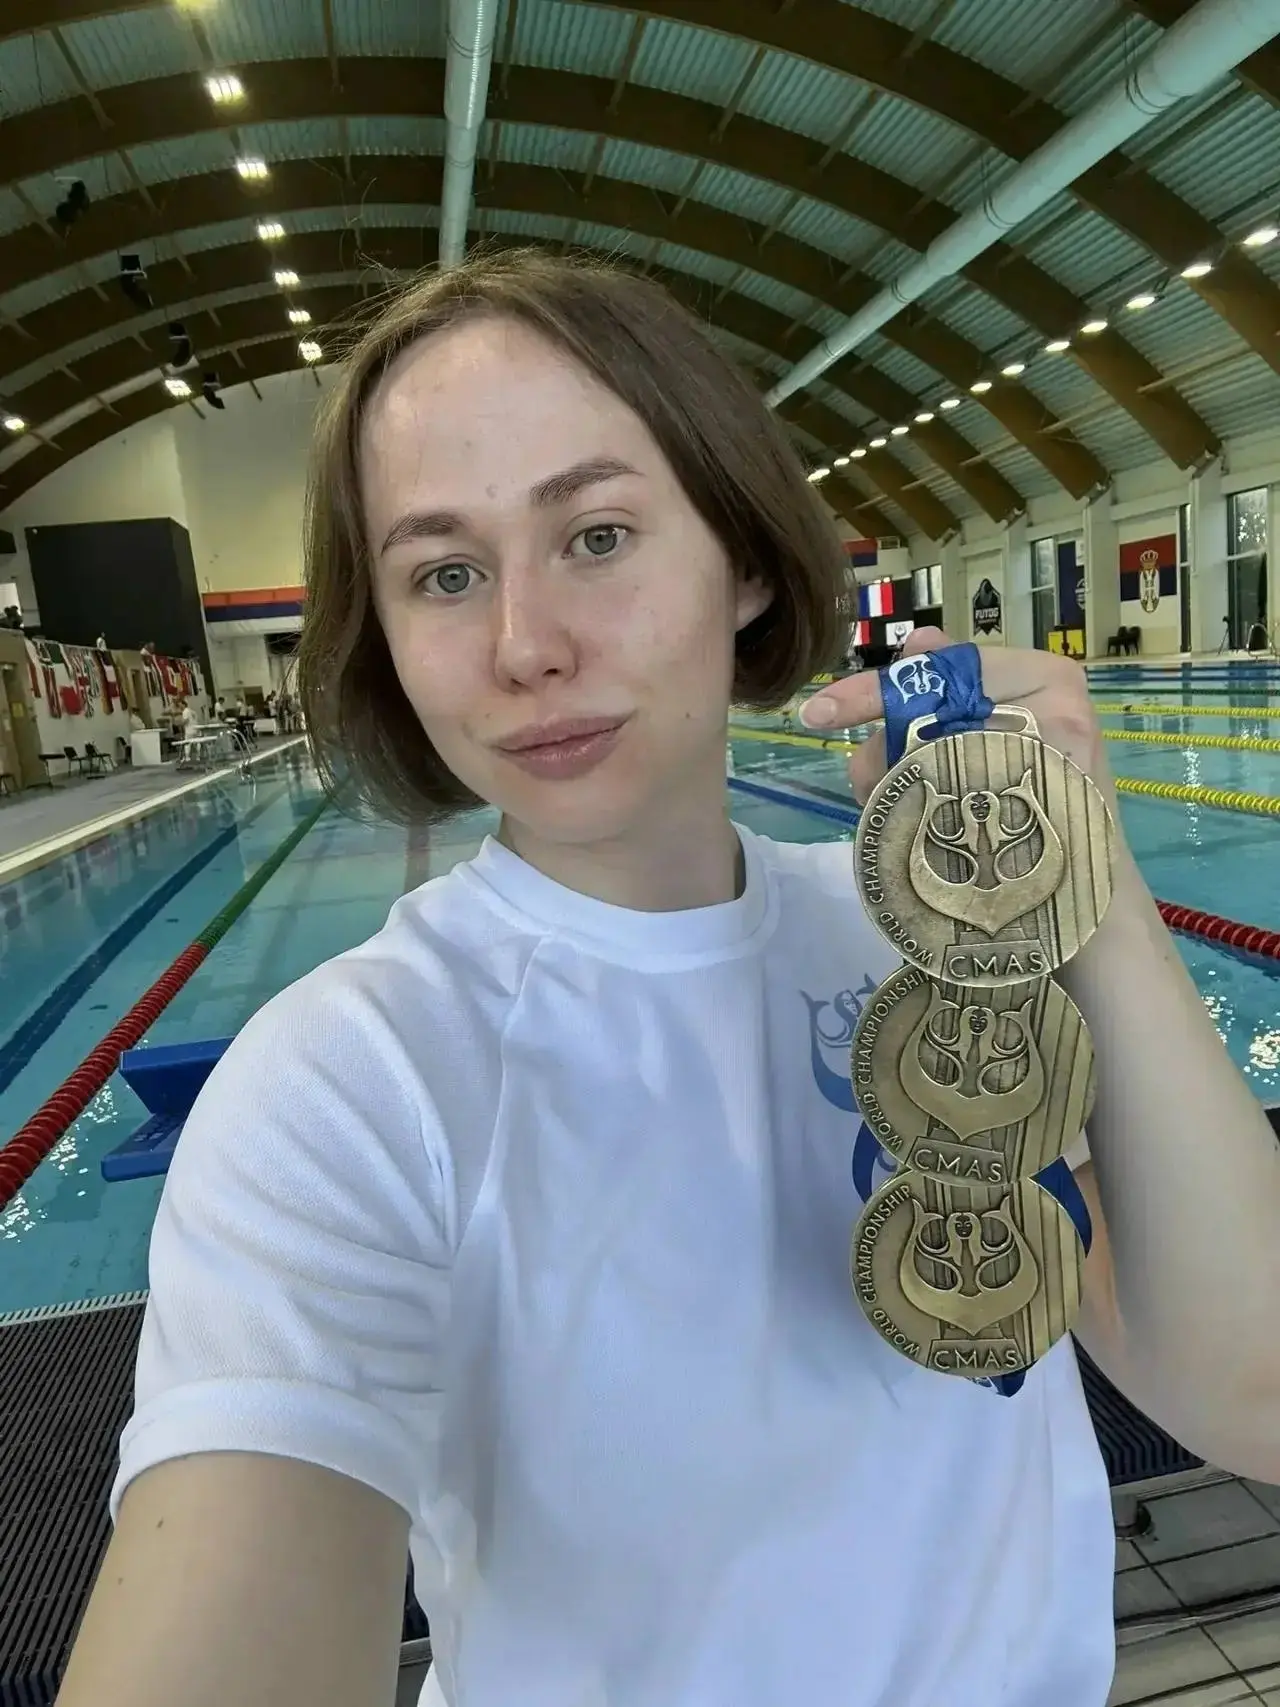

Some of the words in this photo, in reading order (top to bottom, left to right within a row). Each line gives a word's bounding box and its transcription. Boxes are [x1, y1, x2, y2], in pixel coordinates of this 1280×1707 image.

[863, 764, 922, 904] CHAMPIONSHIP
[879, 913, 934, 968] WORLD
[948, 950, 1043, 979] CMAS
[863, 1093, 904, 1152] WORLD
[914, 1148, 1004, 1184] CMAS
[858, 1184, 911, 1304] CHAMPIONSHIP
[872, 1309, 922, 1357] WORLD
[933, 1349, 1018, 1369] CMAS
